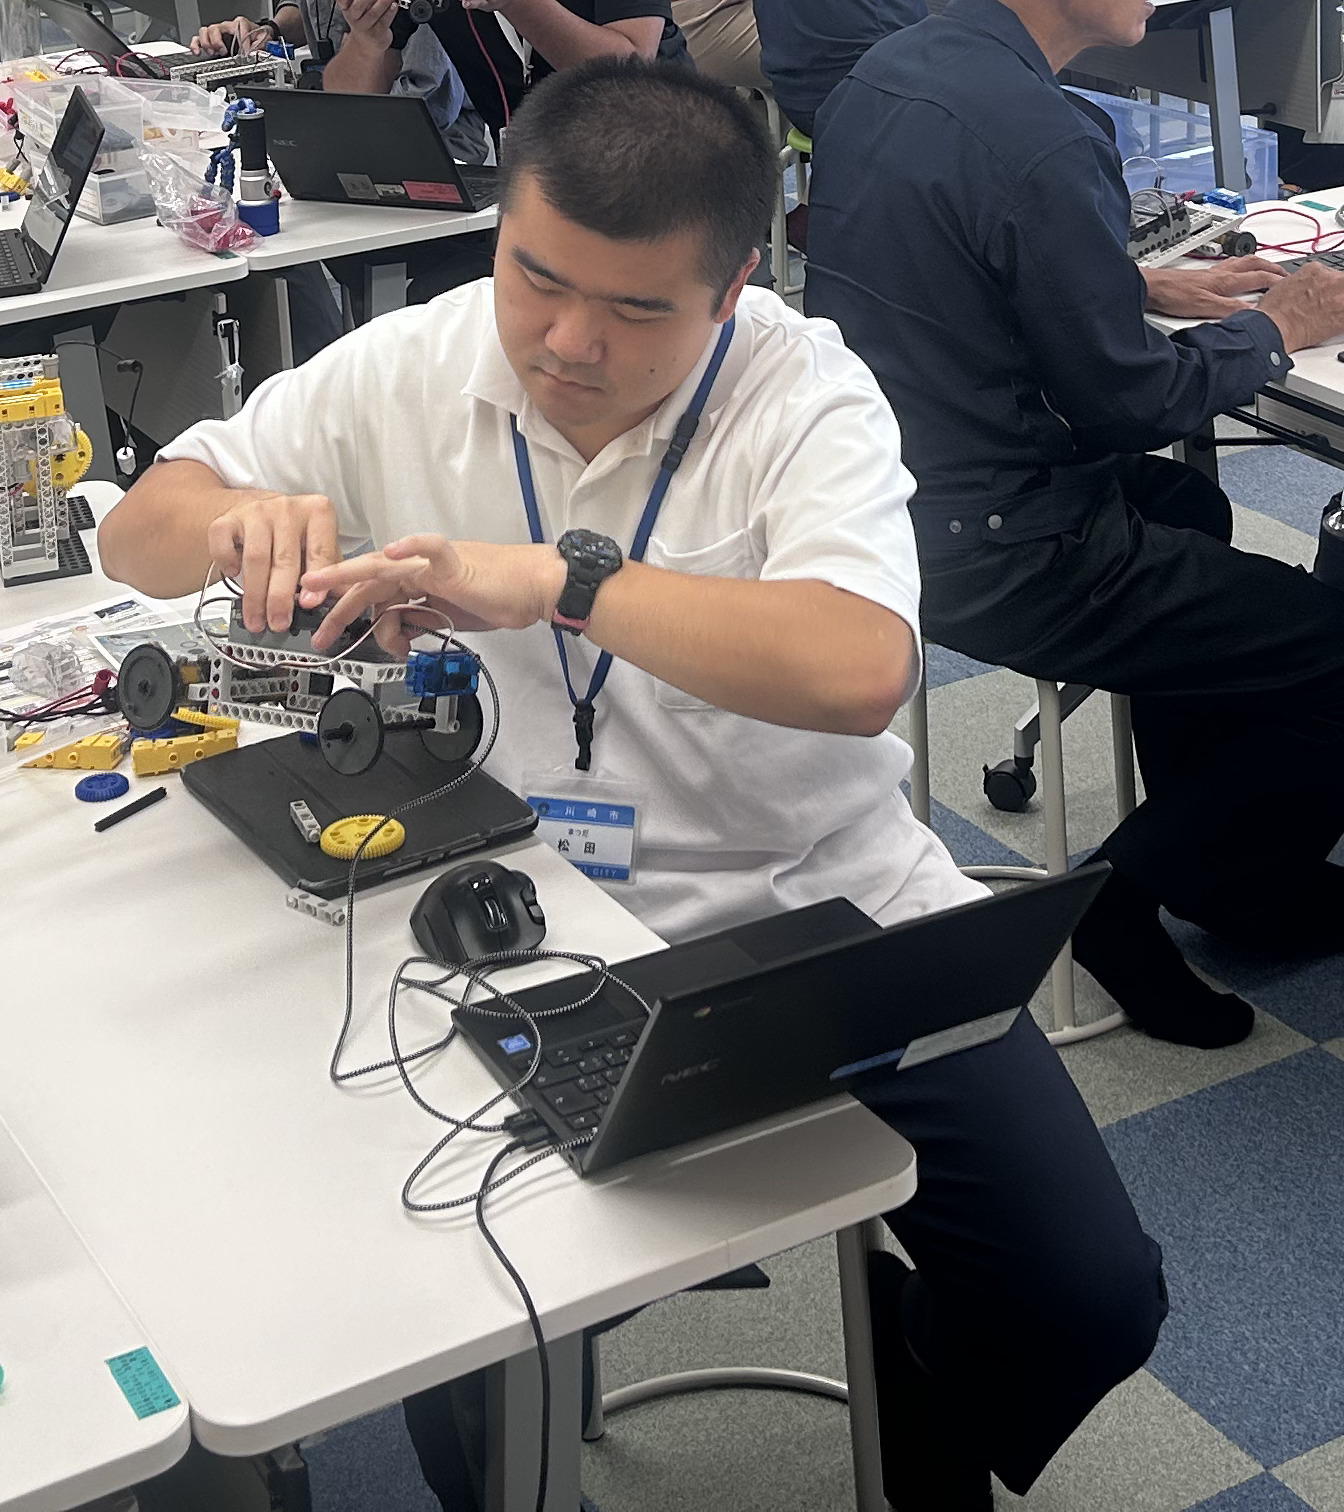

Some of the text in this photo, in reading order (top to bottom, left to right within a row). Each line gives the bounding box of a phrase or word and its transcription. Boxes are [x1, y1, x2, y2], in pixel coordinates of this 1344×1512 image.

[564, 806, 619, 821] 川崎市
[557, 838, 596, 855] 松田
